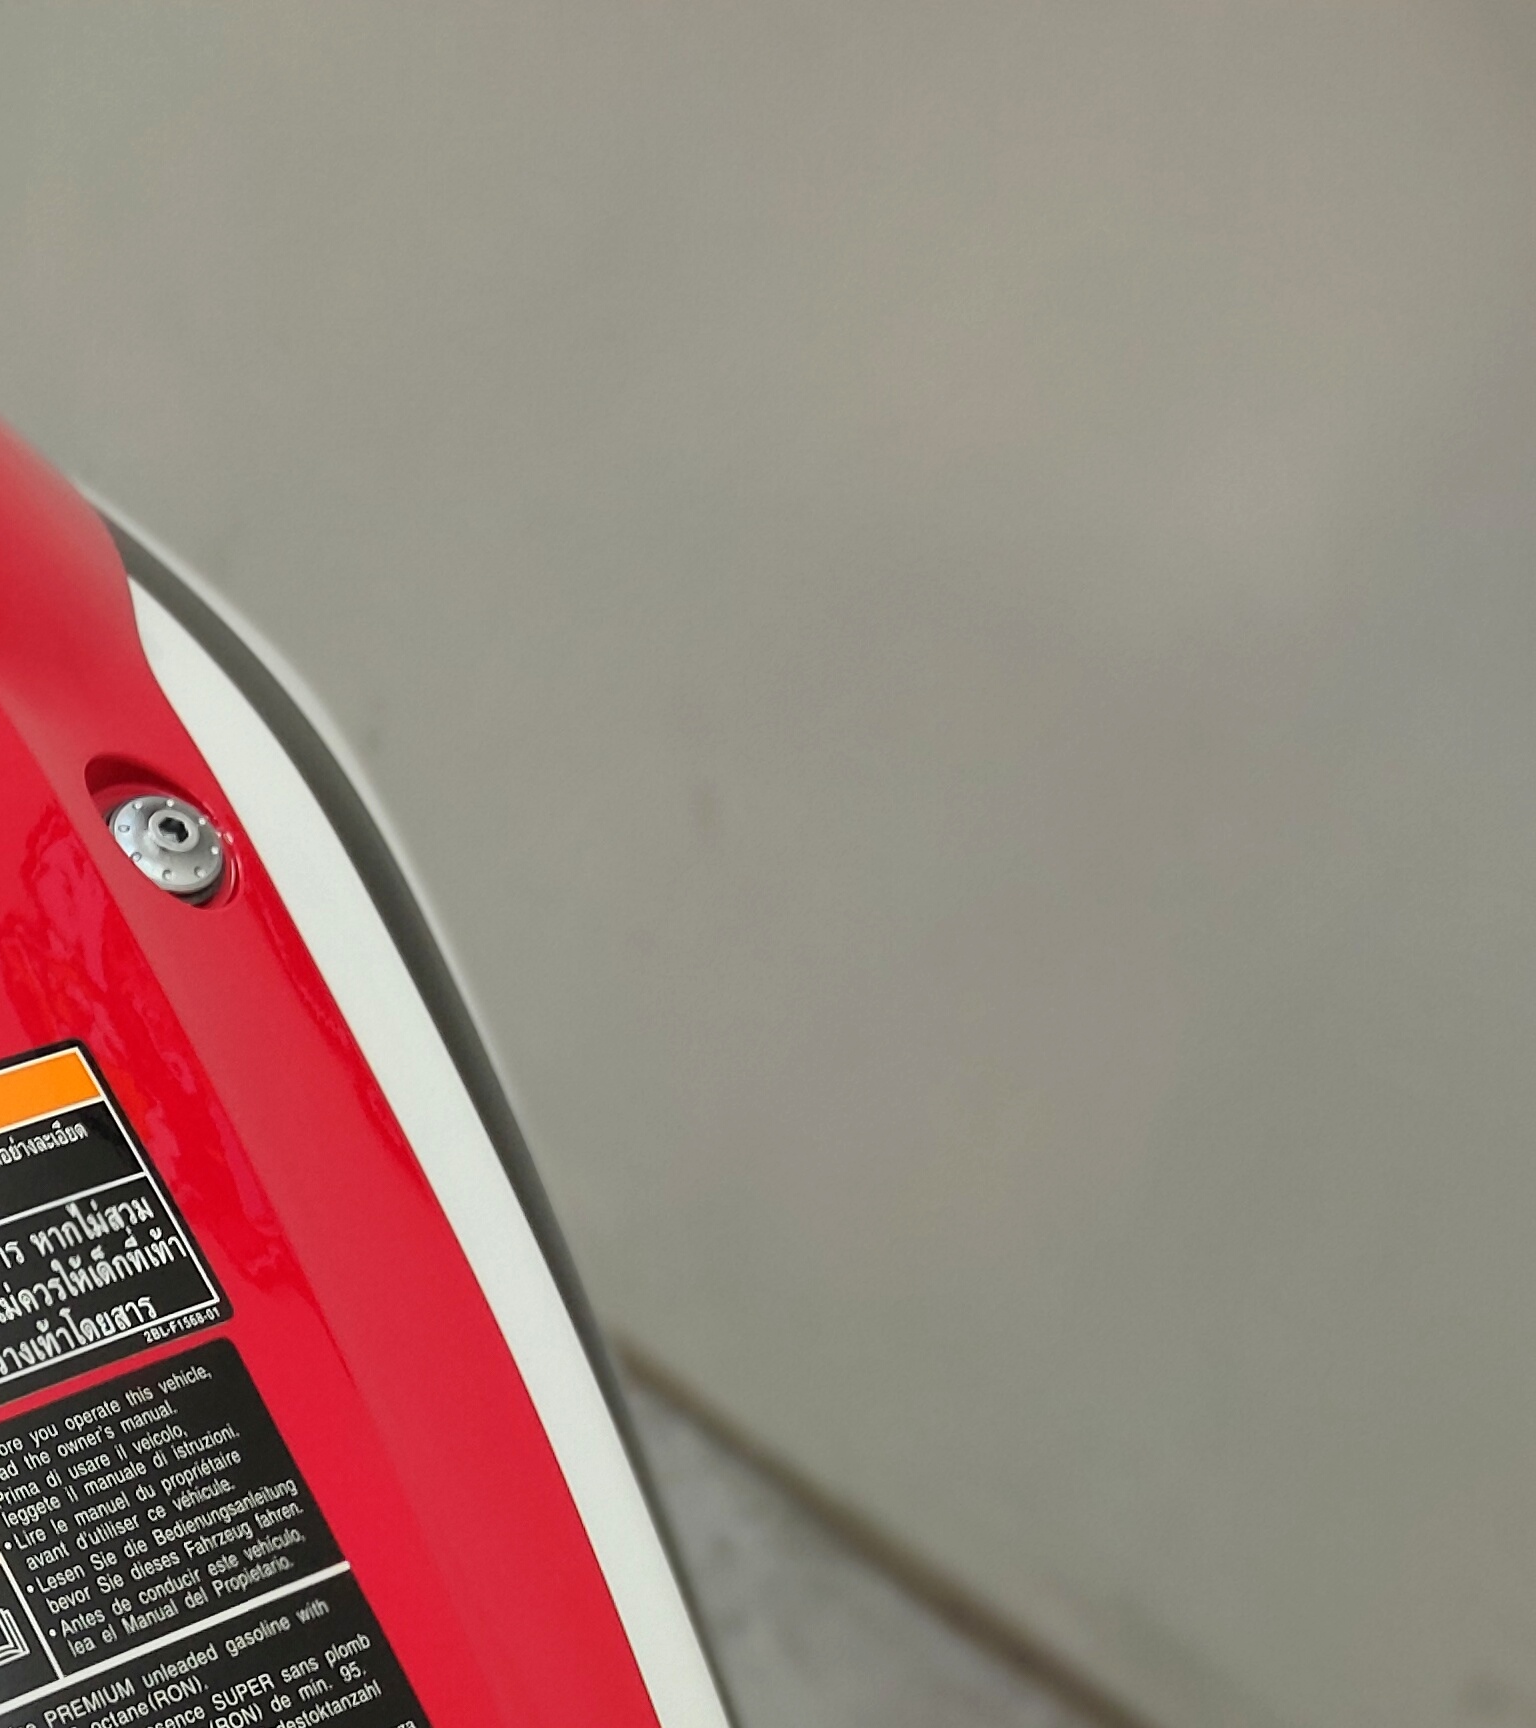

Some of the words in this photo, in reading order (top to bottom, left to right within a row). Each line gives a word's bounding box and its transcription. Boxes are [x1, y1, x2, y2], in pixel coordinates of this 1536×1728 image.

[28, 1195, 155, 1255] หากไม่สวม
[22, 1450, 52, 1473] the
[57, 1424, 116, 1458] owner's
[119, 1398, 179, 1434] manual.
[27, 1423, 59, 1449] you
[64, 1399, 122, 1433] operate
[124, 1385, 154, 1408] this
[157, 1365, 213, 1395] vehicle,
[45, 1467, 63, 1489] di
[67, 1453, 111, 1480] usare
[113, 1442, 129, 1462] il
[131, 1423, 189, 1455] veicolo,
[62, 1484, 80, 1504] il
[83, 1460, 148, 1497] manuale
[152, 1448, 169, 1469] di
[170, 1422, 241, 1462] istruzioni.
[11, 1527, 47, 1553] Lire
[49, 1518, 69, 1538] le
[73, 1490, 131, 1527] manuel
[135, 1483, 157, 1503] du
[160, 1450, 242, 1497] propriétaire
[24, 1539, 71, 1571] avant
[75, 1514, 140, 1551] d'utiliser
[147, 1504, 168, 1522] ce
[34, 1564, 86, 1594] Lesen
[89, 1550, 118, 1572] Sie
[123, 1538, 149, 1559] die
[151, 1478, 299, 1547] Bedienungsanleitung
[44, 1585, 92, 1616] bevor
[96, 1572, 125, 1594] Sie
[130, 1551, 181, 1582] dieses
[183, 1521, 254, 1561] Fahrzeug
[253, 1502, 305, 1531] fahren.
[60, 1608, 106, 1639] Antes
[111, 1596, 133, 1618] de
[137, 1567, 202, 1606] conducir
[207, 1553, 240, 1577] este
[66, 1636, 98, 1659] lea
[101, 1622, 118, 1644] el
[120, 1597, 180, 1637] Manual
[184, 1585, 210, 1610] del
[140, 1642, 219, 1689] unleaded
[224, 1616, 292, 1658] gasoline
[295, 1598, 330, 1625] with
[211, 1673, 276, 1712] SUPER
[280, 1657, 320, 1684] sans
[324, 1633, 371, 1670] plomb
[270, 1693, 293, 1713] de
[297, 1677, 334, 1702] min.
